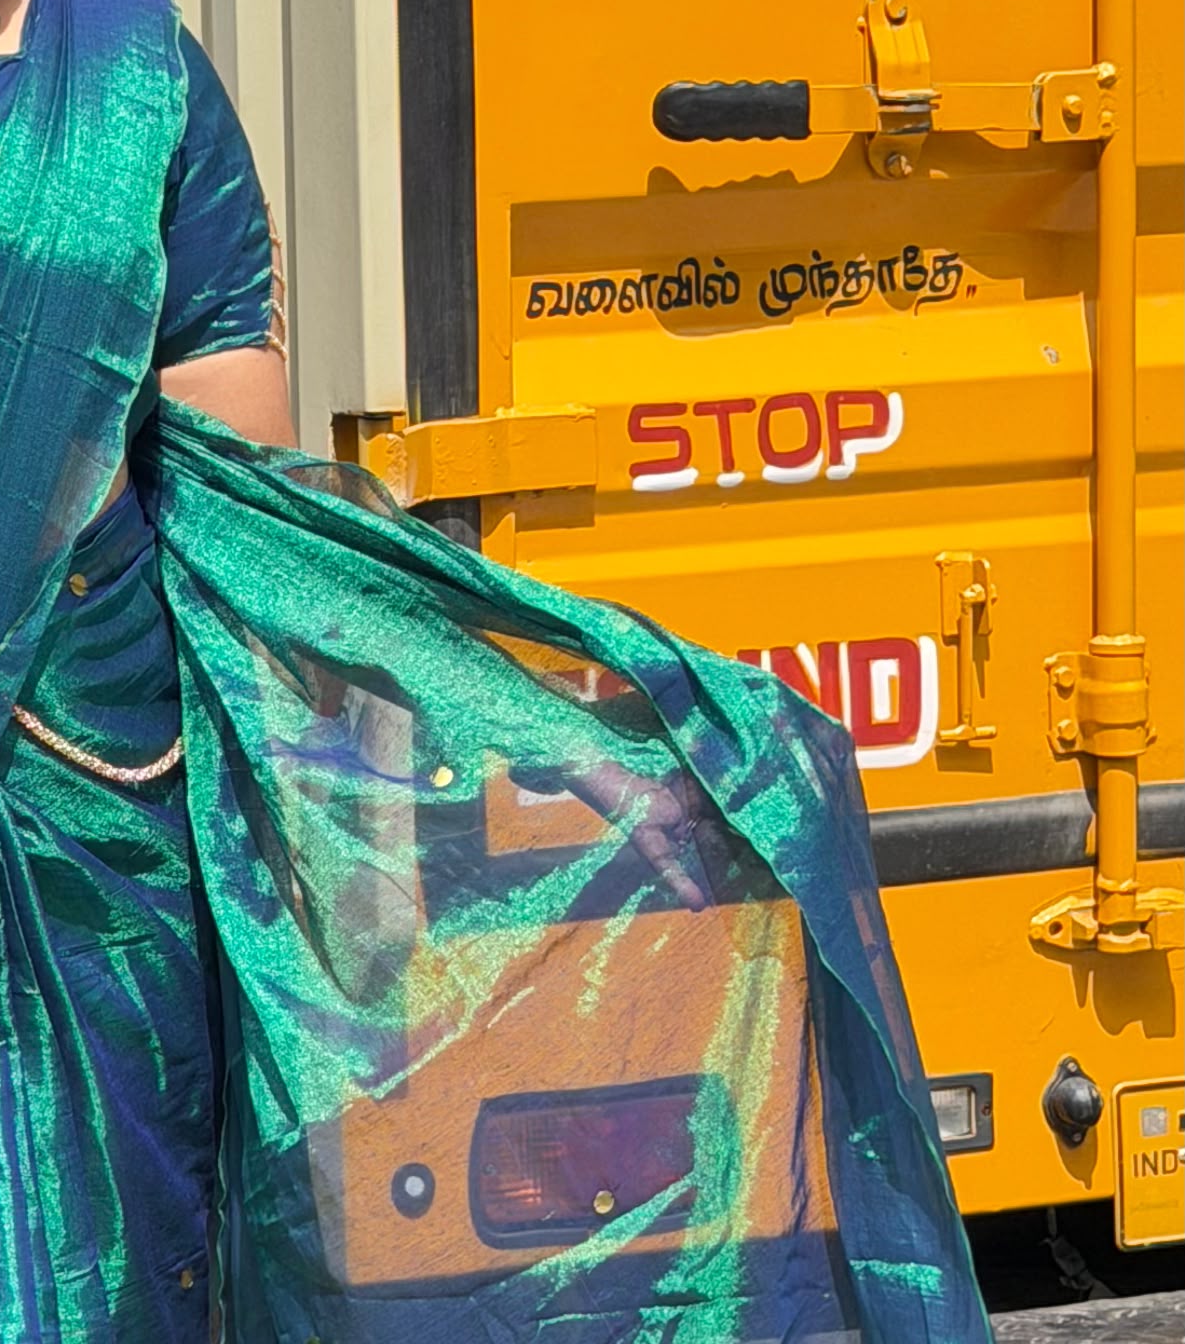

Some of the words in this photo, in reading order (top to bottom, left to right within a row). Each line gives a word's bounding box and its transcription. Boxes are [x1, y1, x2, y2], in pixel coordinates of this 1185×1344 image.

[526, 257, 740, 319] வளைவில்
[627, 390, 904, 492] STOP
[1133, 1149, 1178, 1178] IND
